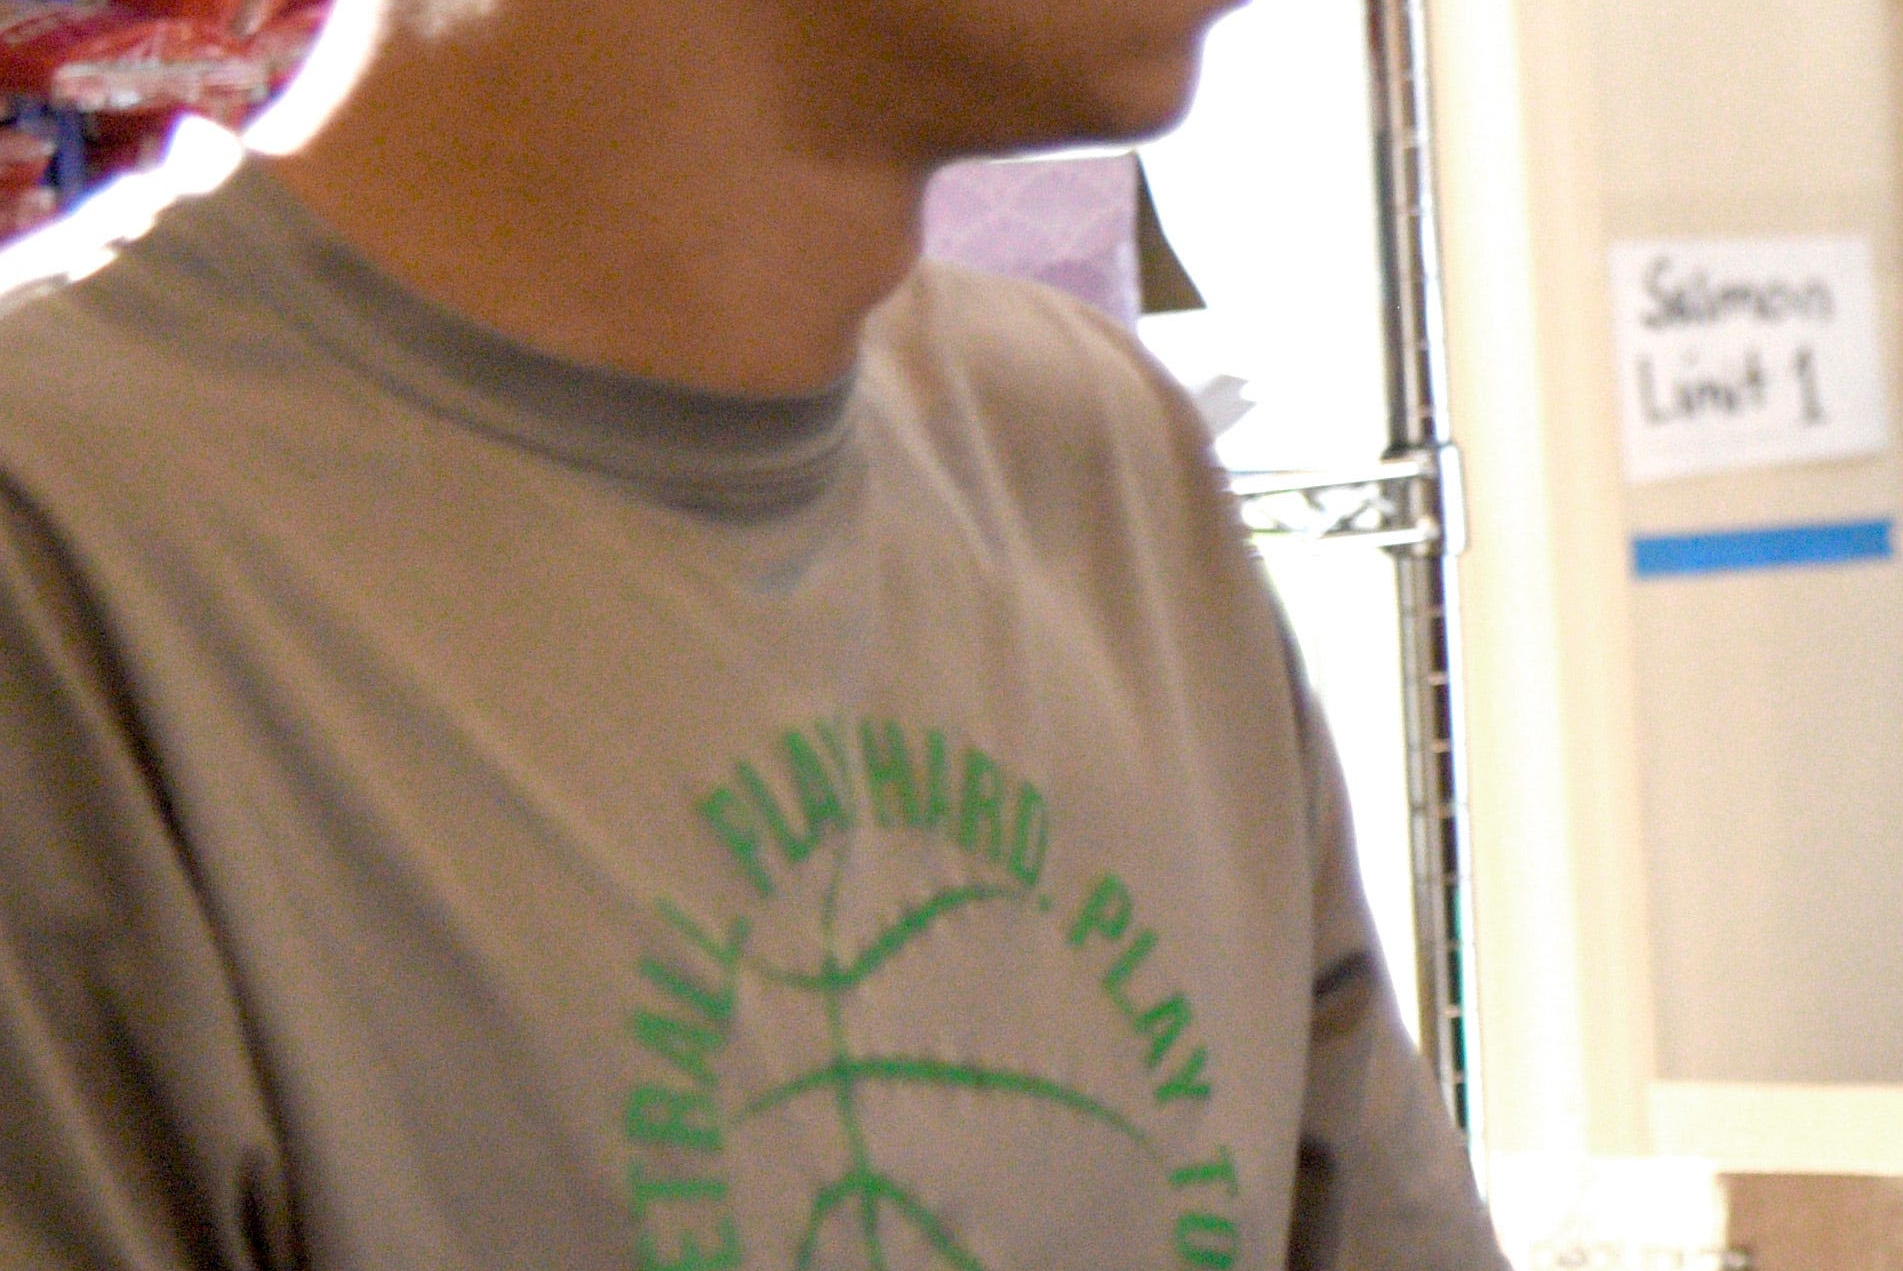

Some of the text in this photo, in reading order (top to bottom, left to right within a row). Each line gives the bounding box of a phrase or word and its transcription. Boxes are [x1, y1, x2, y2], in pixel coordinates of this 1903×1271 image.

[1640, 252, 1834, 330] Salmon
[1636, 344, 1764, 425] Limit
[1066, 871, 1213, 1107] PLAY
